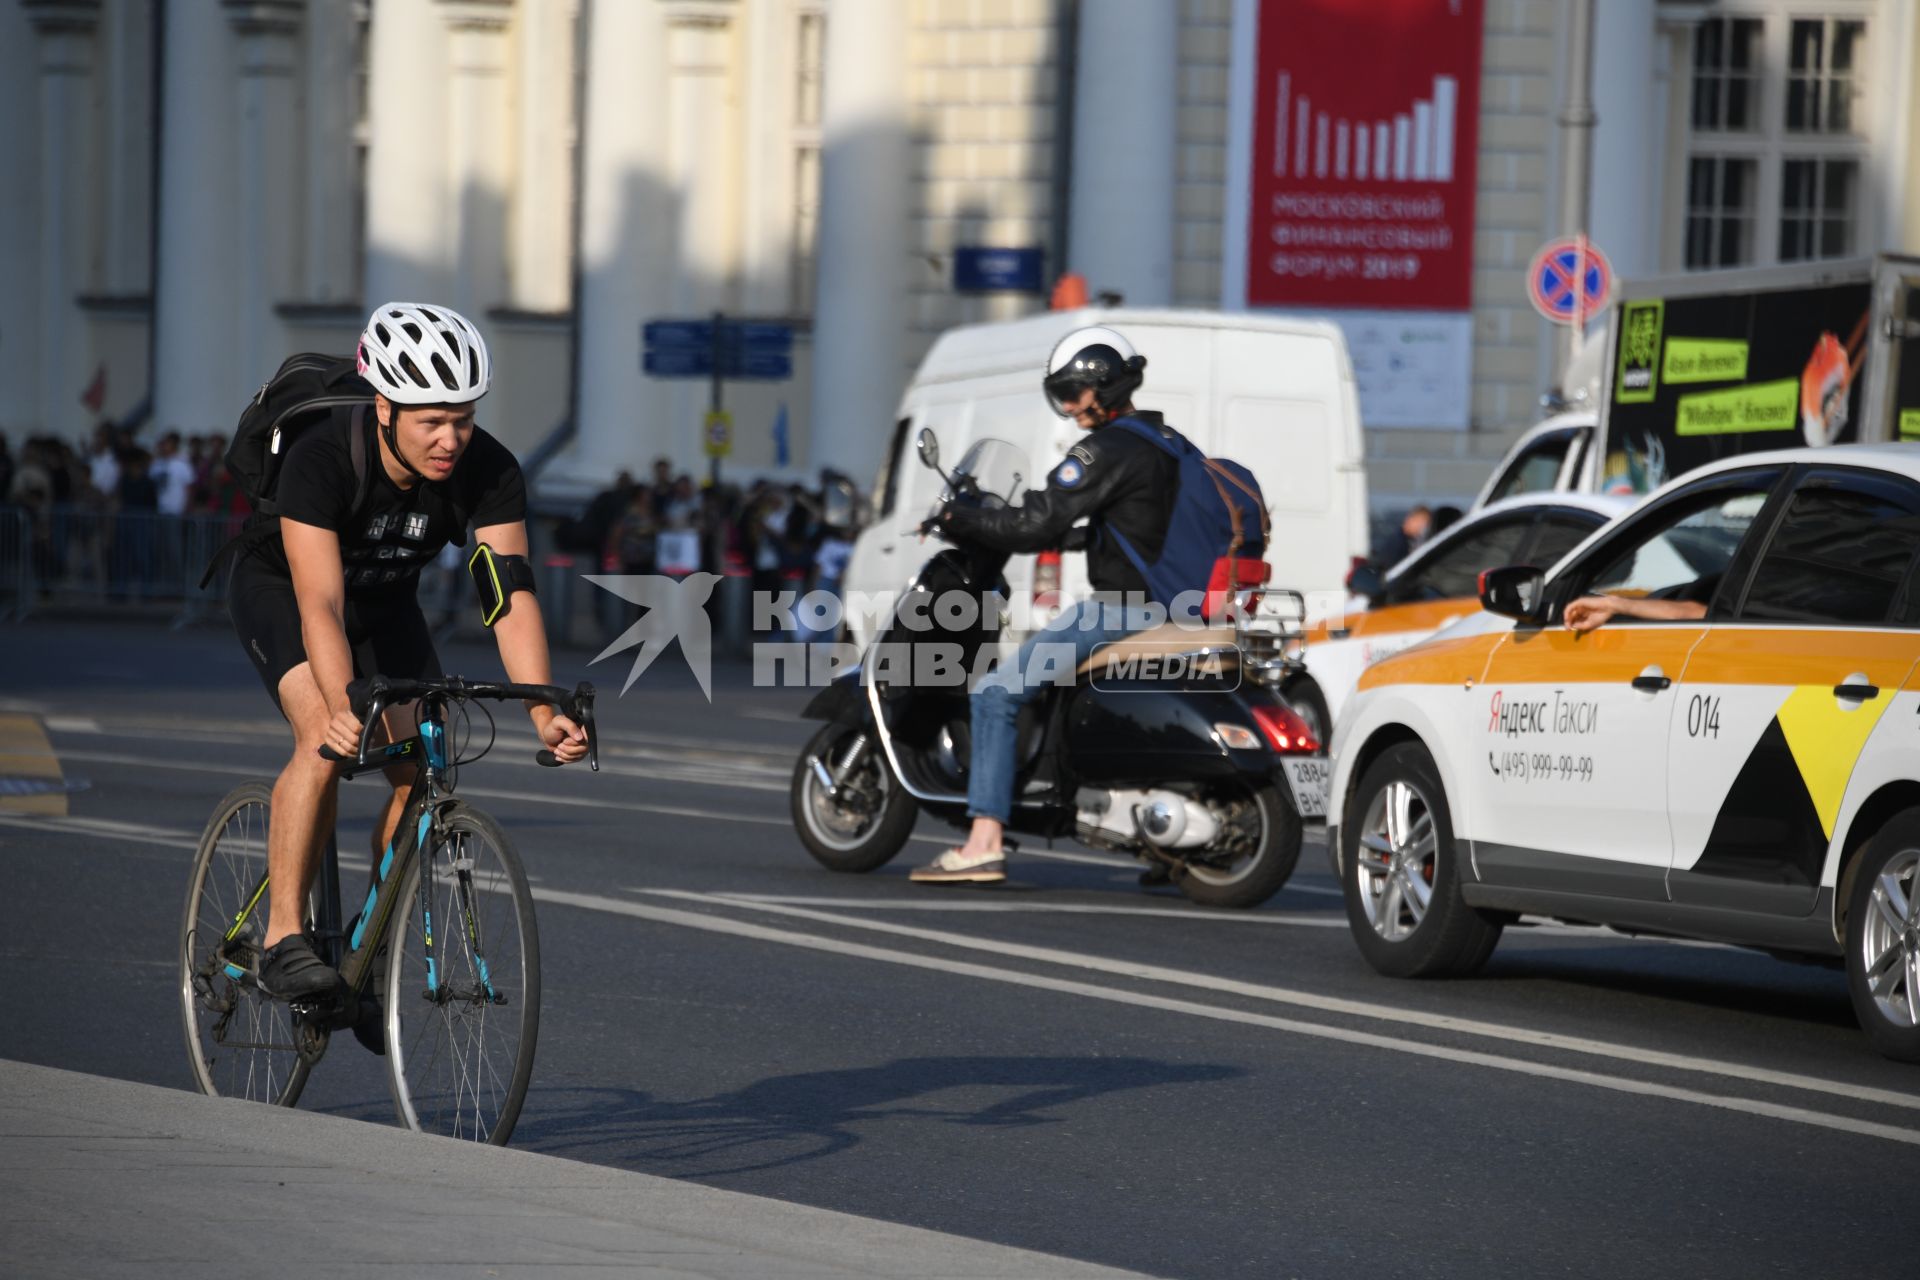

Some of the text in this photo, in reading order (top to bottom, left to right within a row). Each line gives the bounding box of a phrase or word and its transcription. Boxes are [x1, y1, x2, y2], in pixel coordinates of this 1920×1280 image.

[1273, 191, 1445, 219] МОСКОВСКИЙ
[1272, 223, 1453, 249] ФИНАНСОВЫЙ
[1271, 253, 1420, 280] ФОРУМ 2019
[1489, 690, 1599, 738] Яндекс Такси
[1687, 694, 1720, 740] 014
[1501, 752, 1593, 784] (495) 999-99-99
